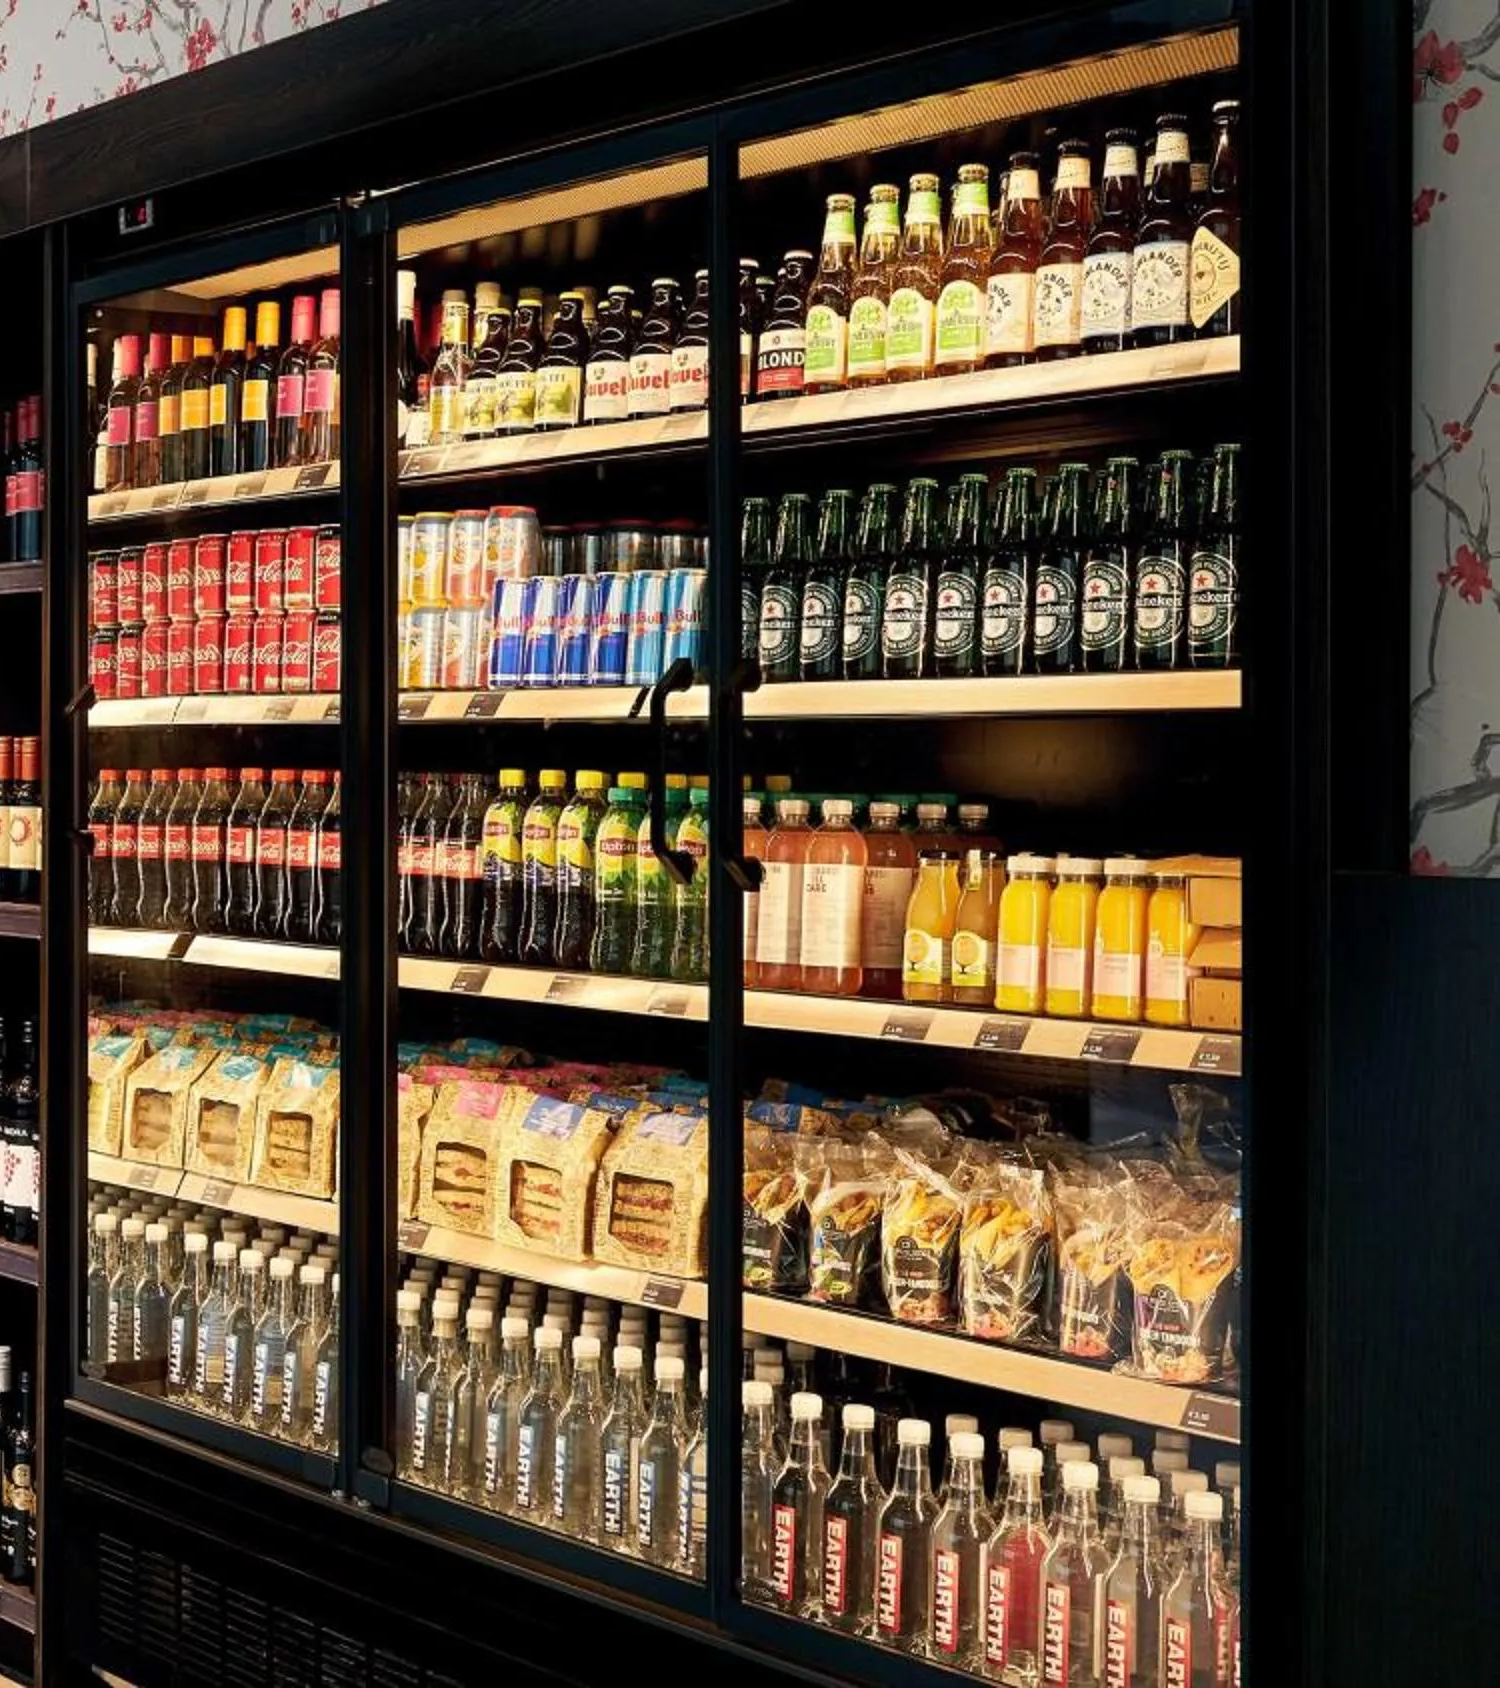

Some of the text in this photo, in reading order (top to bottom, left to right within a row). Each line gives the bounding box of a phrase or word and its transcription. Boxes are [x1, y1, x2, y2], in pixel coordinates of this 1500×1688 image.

[586, 376, 627, 397] uvel
[628, 368, 669, 390] uvel
[517, 1426, 533, 1507] EARTH
[605, 1452, 622, 1533] EARTH
[640, 1462, 655, 1545] EARTH
[773, 1509, 792, 1595] EARTH
[825, 1519, 846, 1612] EARTH
[879, 1538, 898, 1628] EARTH
[935, 1554, 954, 1645] EARTH
[987, 1568, 1006, 1662] EARTH
[1045, 1587, 1065, 1683] EARTH
